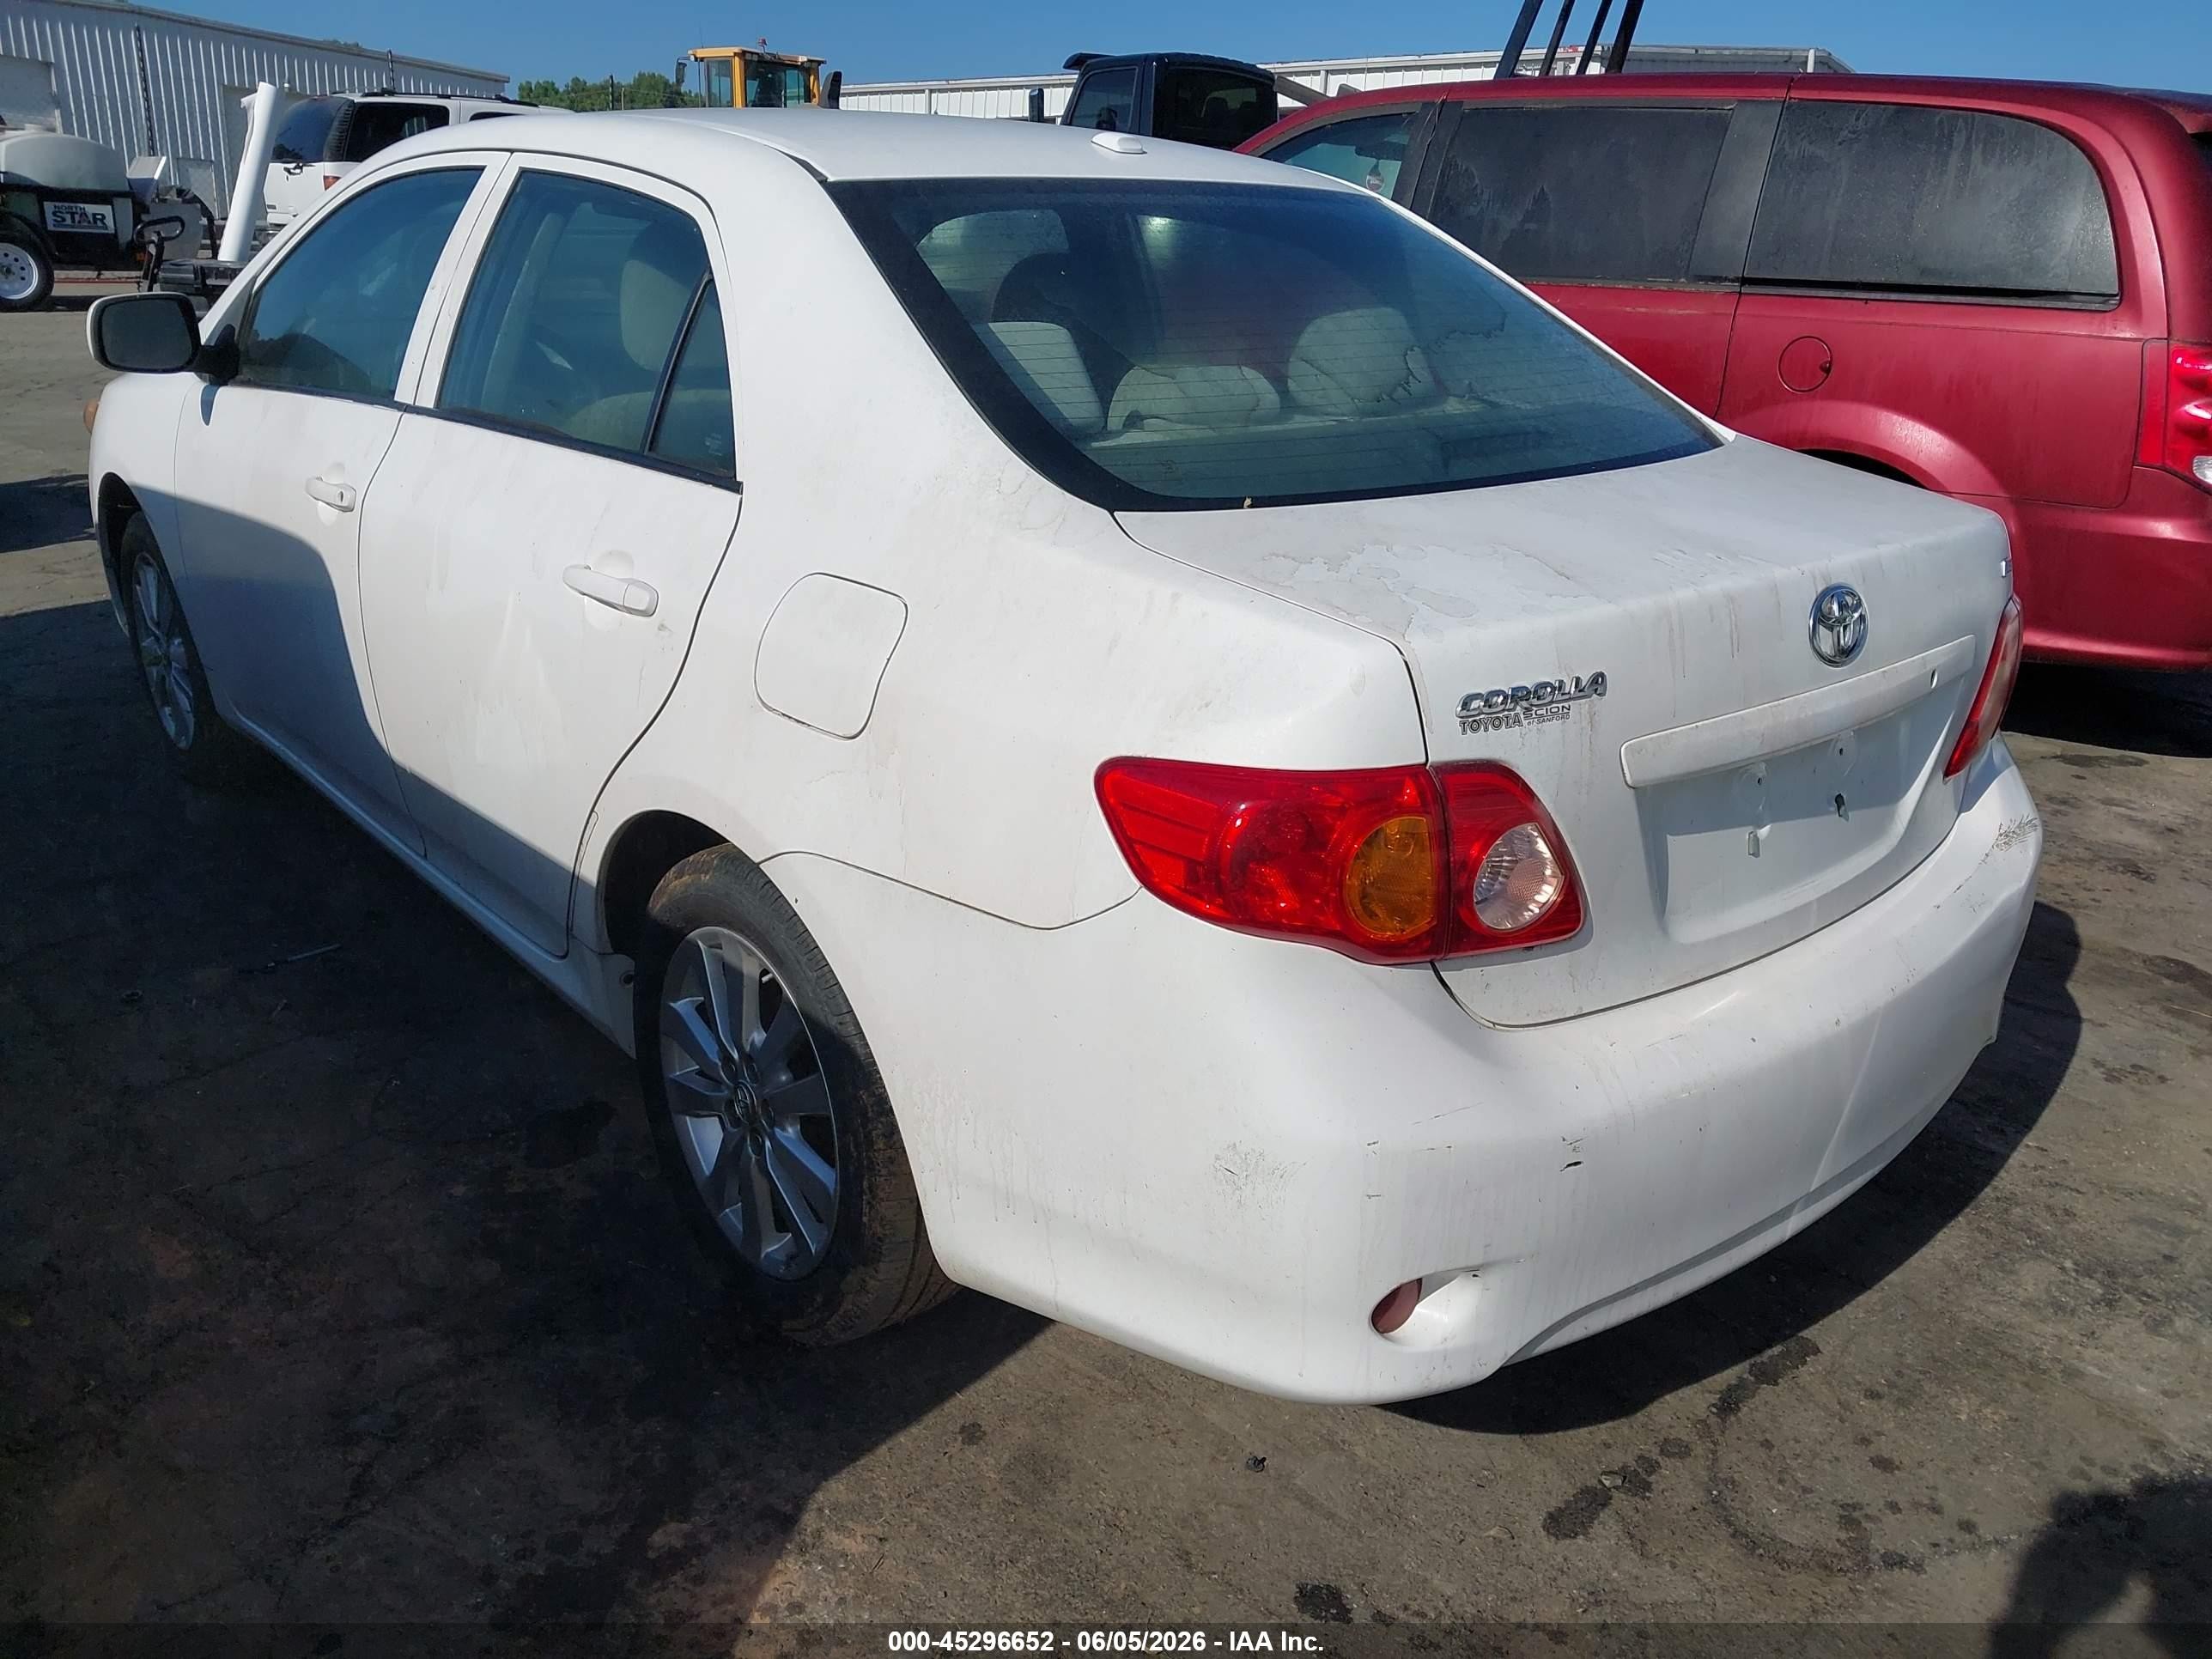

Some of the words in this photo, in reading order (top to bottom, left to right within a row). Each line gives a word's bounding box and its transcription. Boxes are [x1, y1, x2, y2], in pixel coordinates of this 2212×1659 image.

[53, 204, 86, 213] NORTH
[52, 210, 108, 230] STAR
[1455, 671, 1607, 719] COROLLA
[1522, 704, 1571, 718] SCION
[1536, 714, 1571, 725] SANFORD
[1459, 713, 1523, 736] TOYOTA
